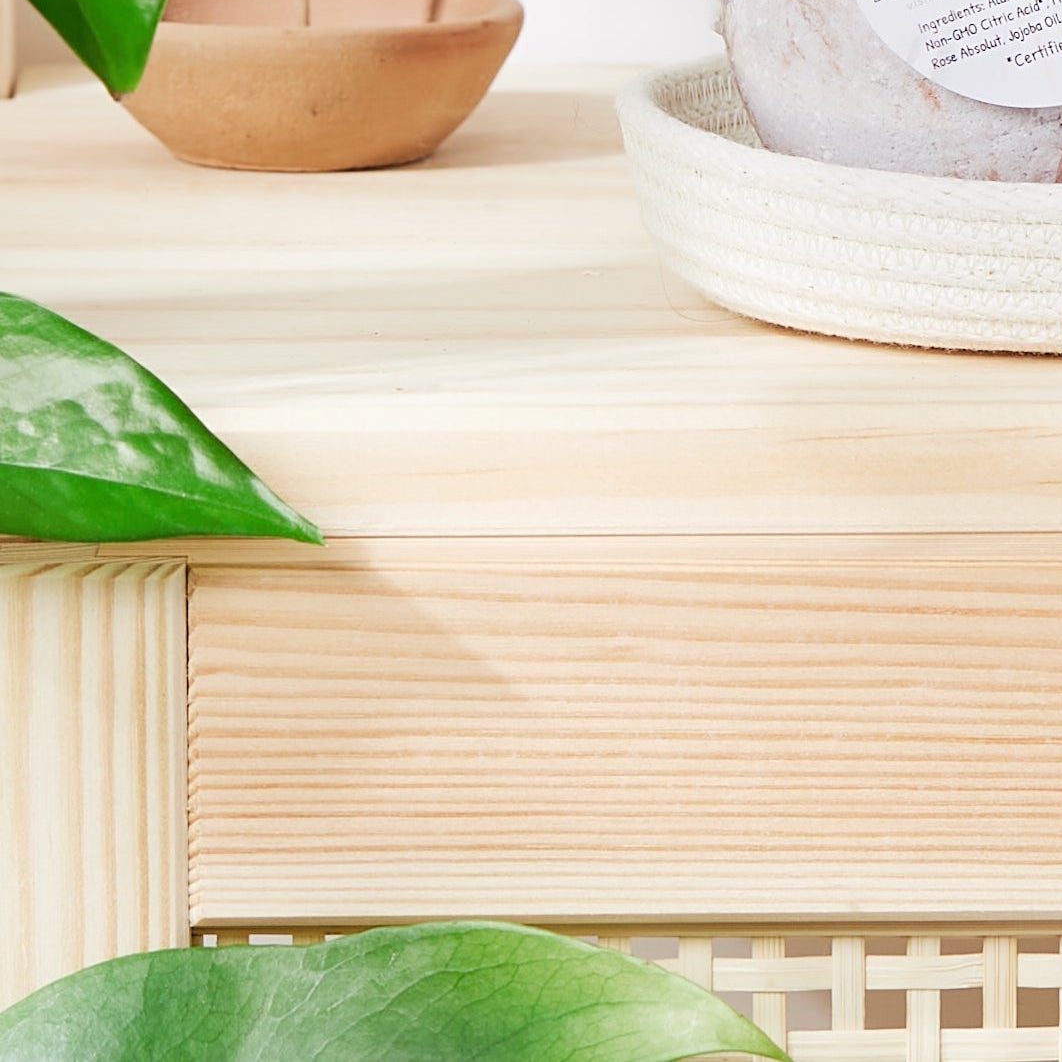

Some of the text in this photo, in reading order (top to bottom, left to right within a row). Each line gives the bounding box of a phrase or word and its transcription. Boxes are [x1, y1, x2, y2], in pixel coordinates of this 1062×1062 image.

[917, 3, 986, 35] Ingredients:
[925, 23, 978, 52] Non-GMO
[980, 11, 1015, 31] Citric
[931, 13, 1062, 70] Rose Absolut, Jojoba Oil
